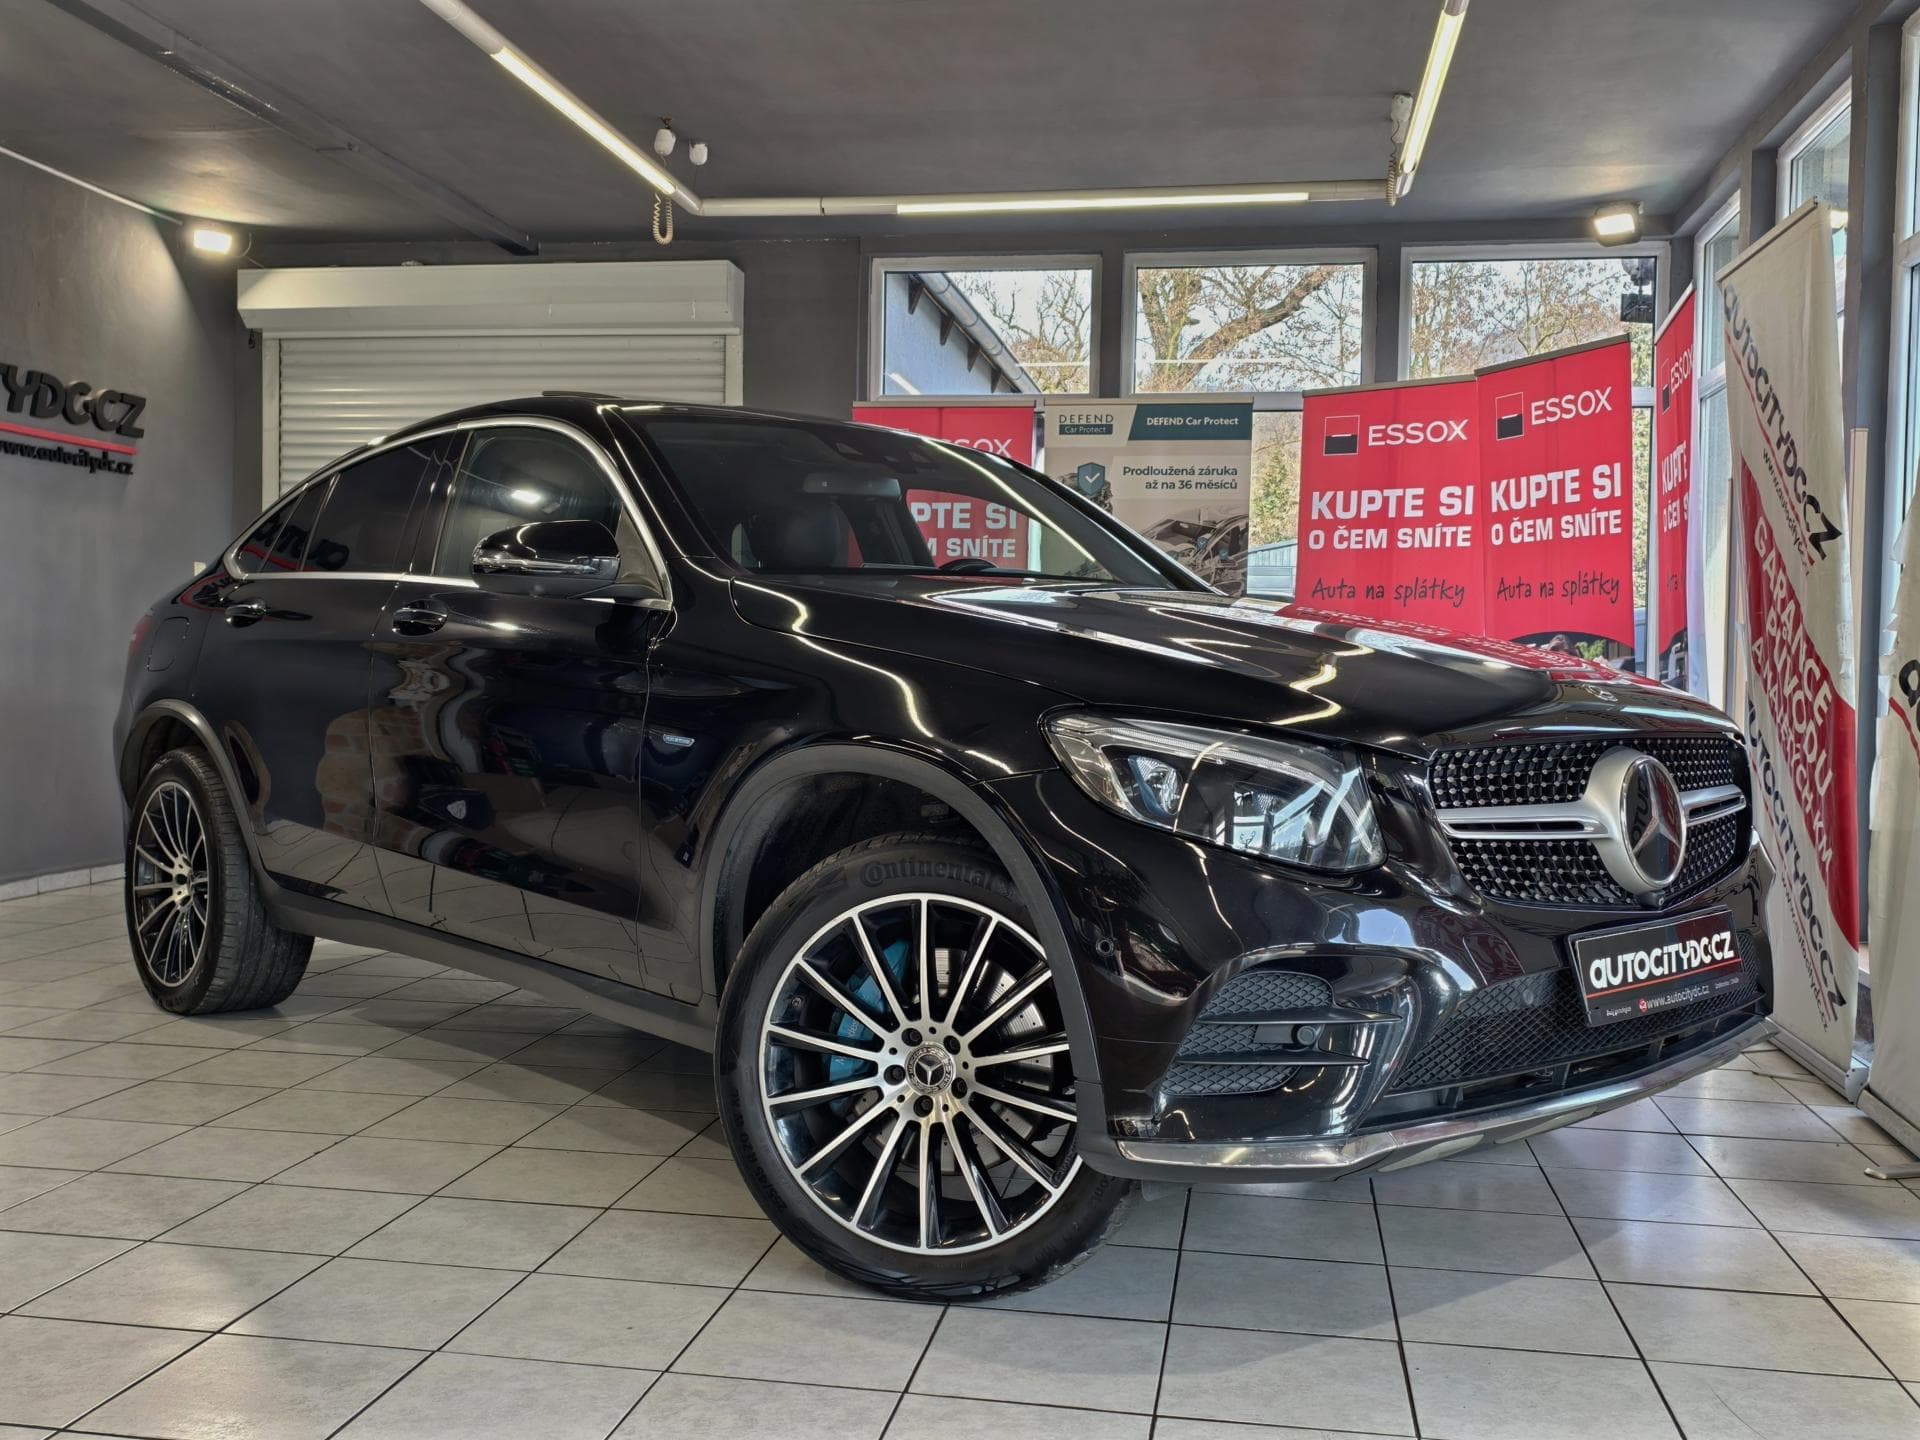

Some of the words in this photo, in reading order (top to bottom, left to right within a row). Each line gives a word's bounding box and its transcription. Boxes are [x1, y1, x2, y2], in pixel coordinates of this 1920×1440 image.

[1059, 414, 1114, 424] DEFEND
[1531, 386, 1612, 426] ESSOX
[1065, 426, 1078, 434] Car
[1079, 425, 1106, 434] Protect
[1146, 417, 1183, 426] DEFEND
[1185, 416, 1202, 426] Car
[1204, 416, 1239, 426] Protect
[1368, 419, 1469, 446] ESSOX
[1123, 466, 1195, 476] Prodloužená
[1198, 466, 1238, 476] záruka
[1145, 479, 1158, 490] až
[1161, 481, 1176, 490] na
[1178, 480, 1192, 490] 36
[1195, 479, 1238, 490] měsíců
[1491, 469, 1581, 513] KUPTE
[1592, 462, 1622, 500] SI
[910, 502, 971, 529] PTE
[985, 502, 1017, 529] SI
[1312, 488, 1425, 520] KUPTE
[1439, 485, 1475, 517] SI
[1308, 530, 1325, 550] O
[1333, 525, 1388, 549] ČEM
[1397, 523, 1472, 548] SNÍTE
[1491, 524, 1504, 546] O
[1510, 517, 1553, 544] ČEM
[1561, 508, 1622, 539] SNÍTE
[946, 534, 1016, 558] SNÍTE
[1312, 577, 1356, 600] Auta
[1365, 586, 1385, 599] na
[1394, 577, 1465, 607] splátky
[1497, 576, 1532, 600] Auta
[1540, 581, 1554, 598] na
[1562, 571, 1620, 604] splátky
[860, 857, 992, 888] Continental
[1646, 984, 1710, 1009] www.autocitydc.cz
